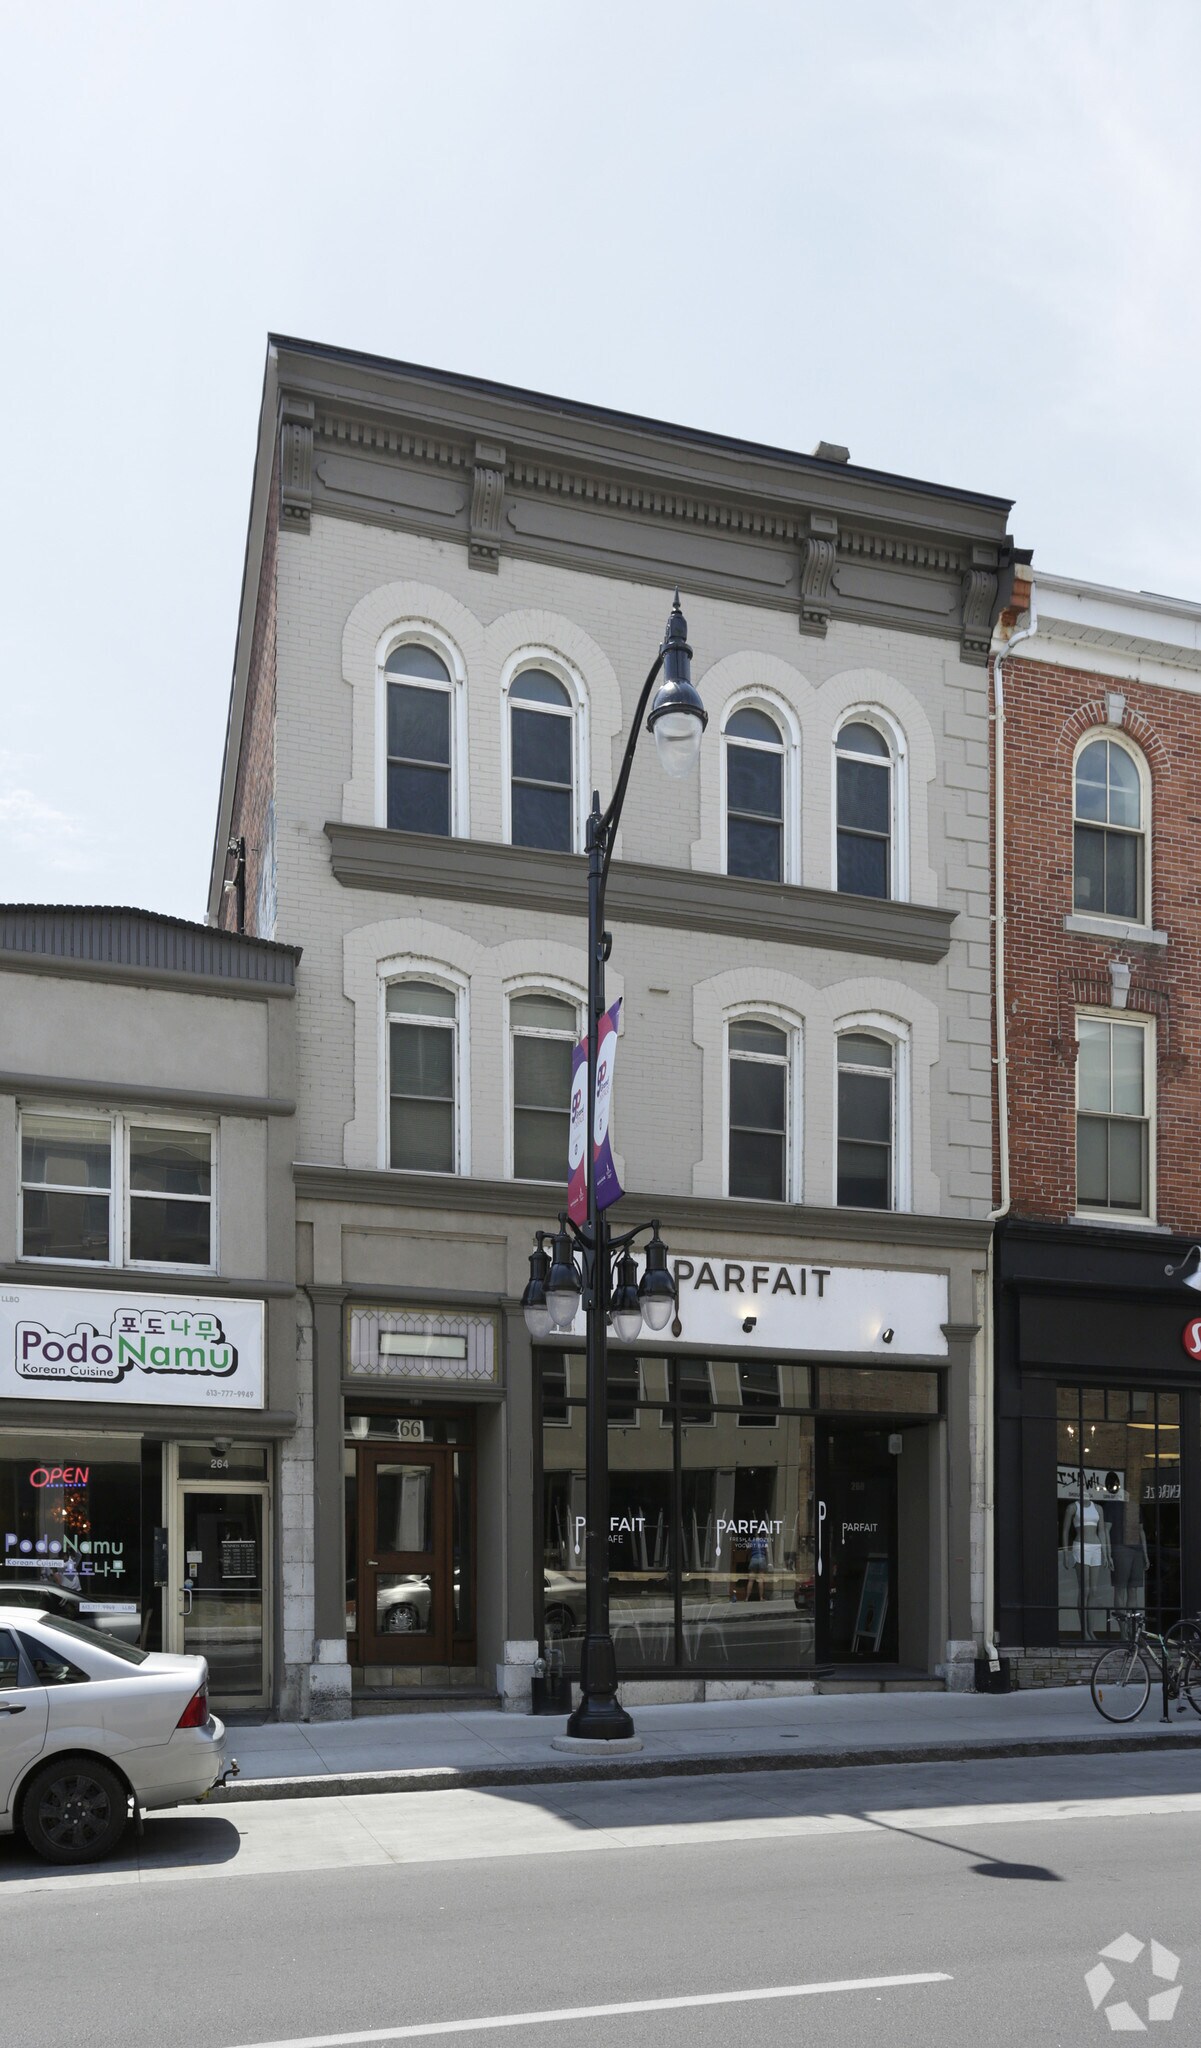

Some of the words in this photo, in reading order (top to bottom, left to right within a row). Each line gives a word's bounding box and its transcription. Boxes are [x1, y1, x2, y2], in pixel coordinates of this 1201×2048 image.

[674, 1259, 831, 1314] PARFAIT
[1, 1295, 20, 1304] LLBO
[118, 1316, 217, 1341] 포도나무
[22, 1330, 230, 1369] PodoNamu
[22, 1363, 66, 1376] Korean
[70, 1365, 114, 1377] Cuisine
[205, 1389, 254, 1399] 613-777-9949
[210, 1459, 229, 1469] 264
[29, 1467, 89, 1488] OPEN
[716, 1519, 783, 1543] PARFAIT
[842, 1522, 878, 1537] PARFAIT
[5, 1533, 124, 1555] PodoNamu
